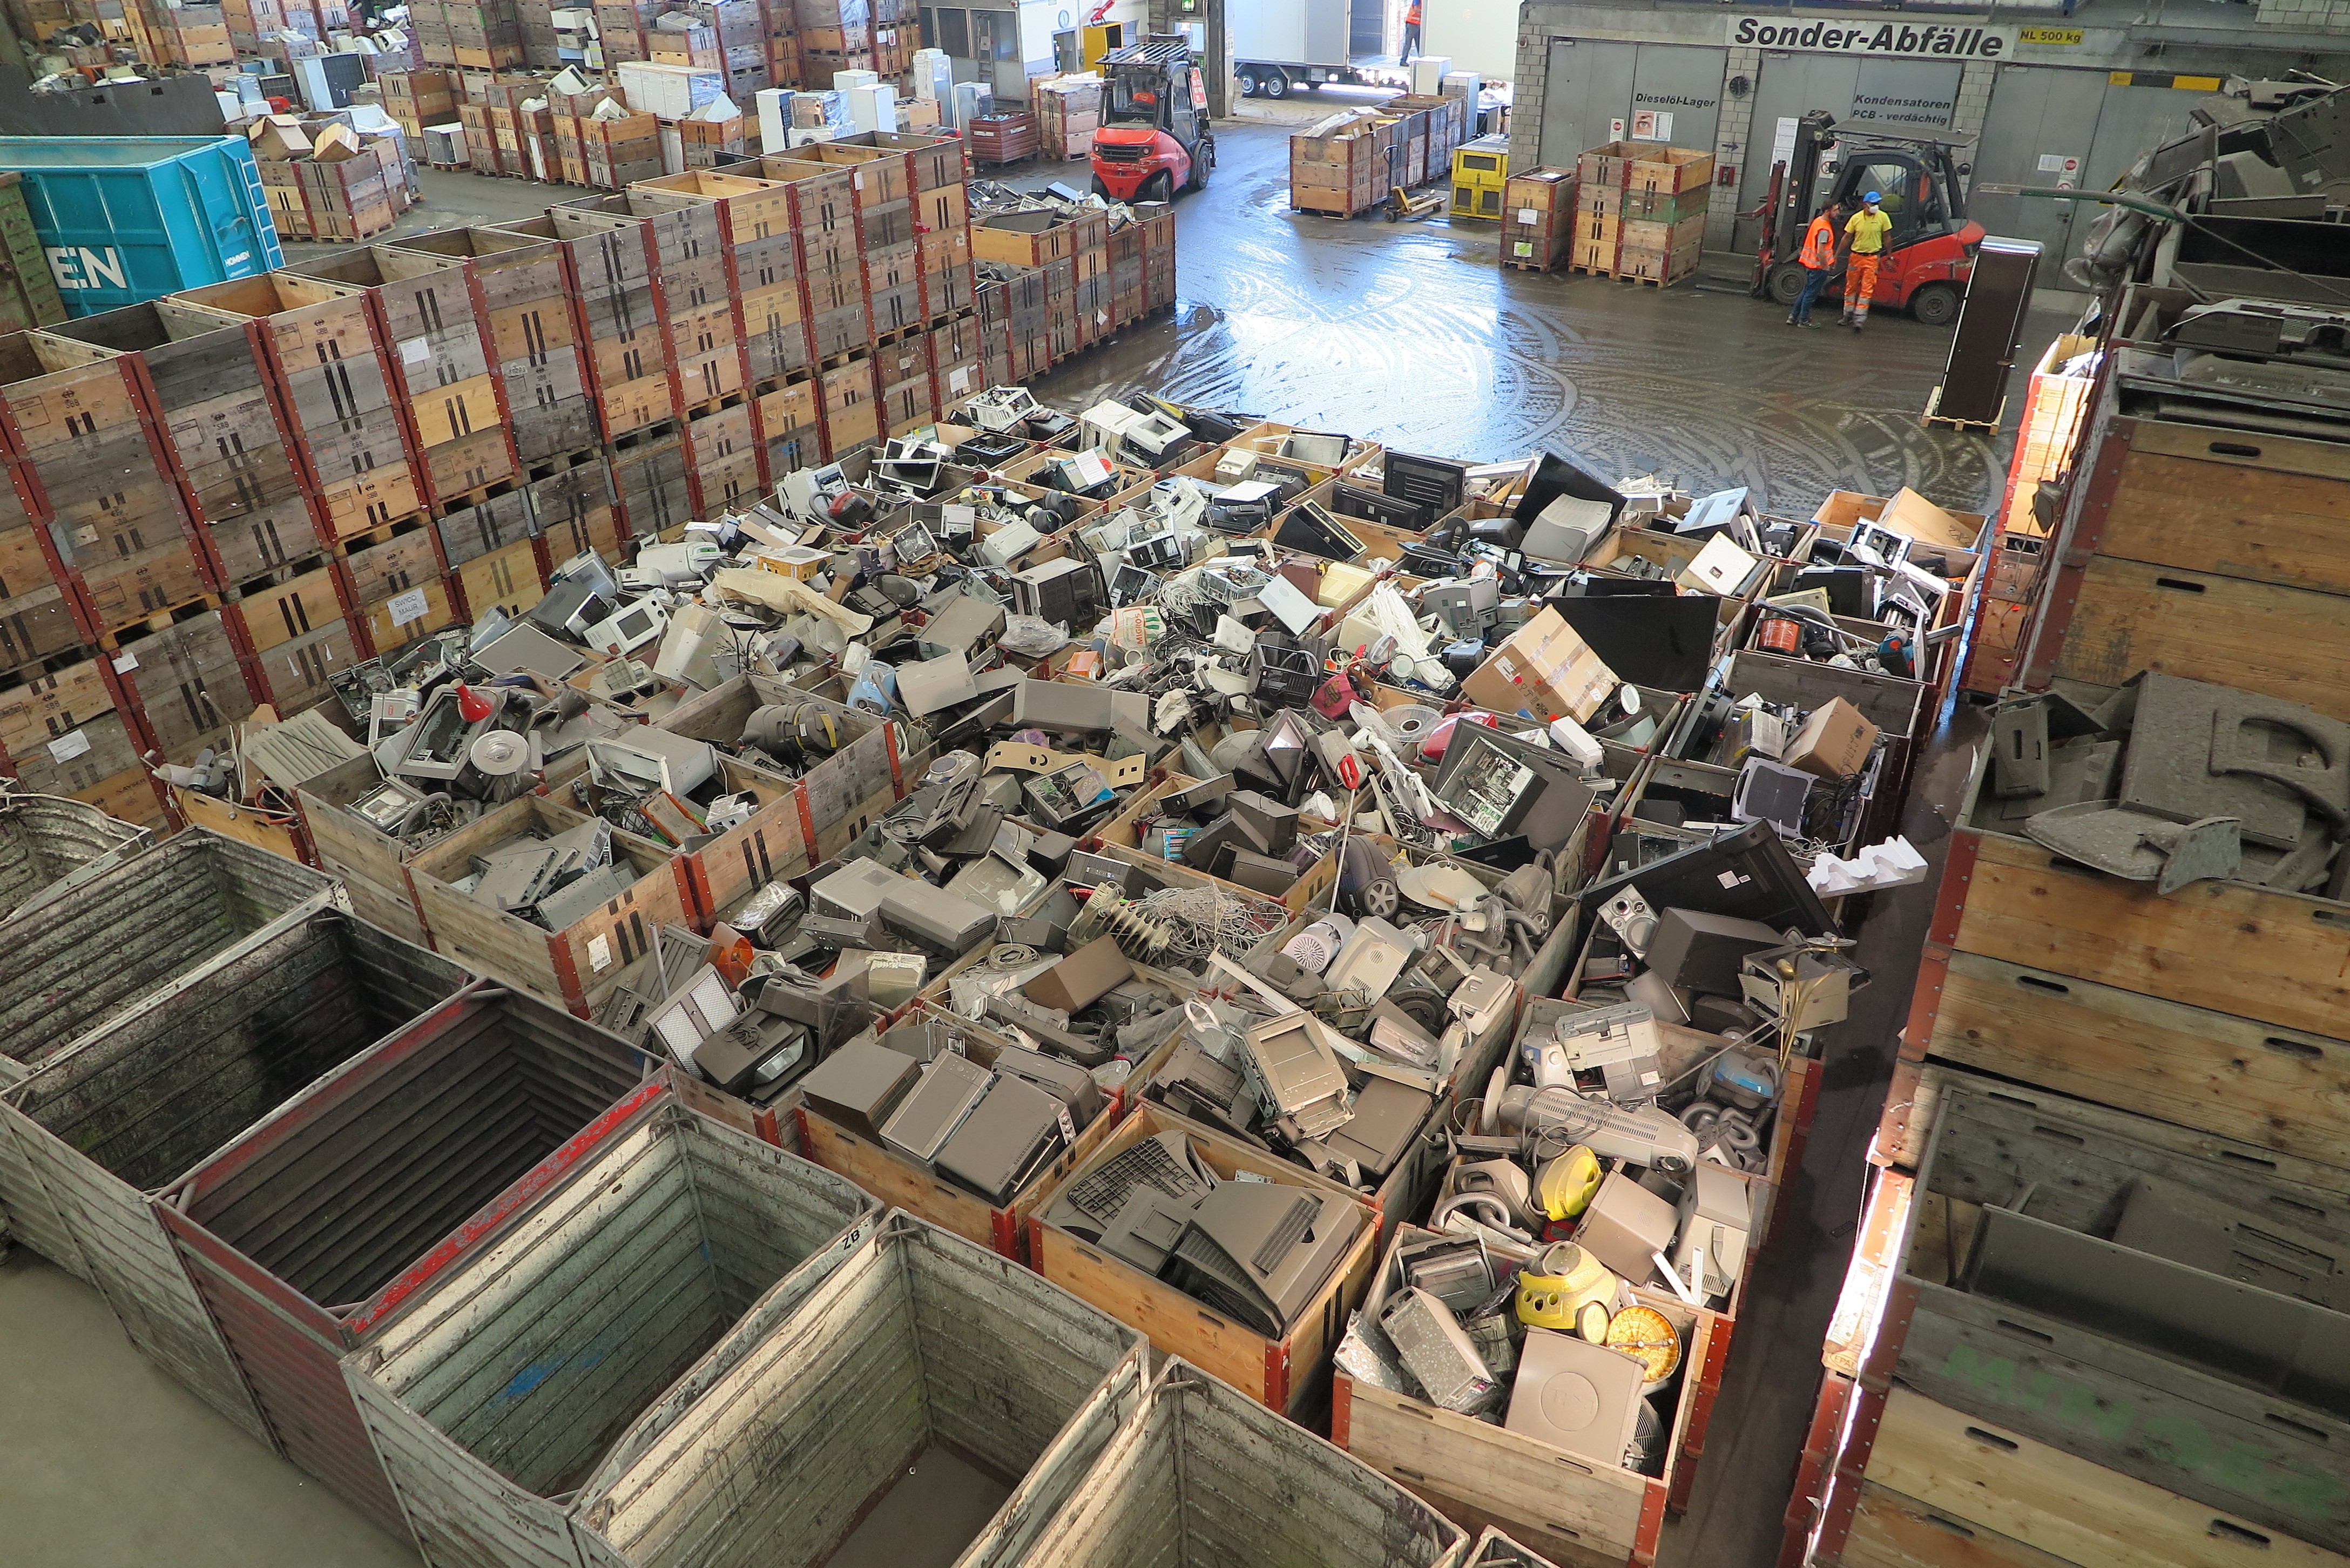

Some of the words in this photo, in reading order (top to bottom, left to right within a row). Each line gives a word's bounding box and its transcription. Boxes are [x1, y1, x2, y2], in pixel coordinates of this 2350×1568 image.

[1734, 18, 2003, 57] Sonder-Abfälle
[2021, 31, 2036, 39] NL
[2041, 31, 2062, 40] 500
[2066, 32, 2081, 43] kg
[1635, 93, 1716, 108] Dieselöl-Lager
[1854, 94, 1951, 109] Kondensatoren
[1852, 109, 1876, 119] PCB
[1886, 112, 1948, 126] verdächtig
[44, 246, 127, 289] EN
[65, 399, 80, 409] SBB
[216, 421, 229, 430] SBB
[352, 441, 363, 449] SBB
[367, 491, 378, 499] SBB
[139, 575, 152, 585] SBB
[394, 594, 417, 607] SWICO
[399, 603, 418, 616] MAUR
[45, 700, 60, 711] SBB
